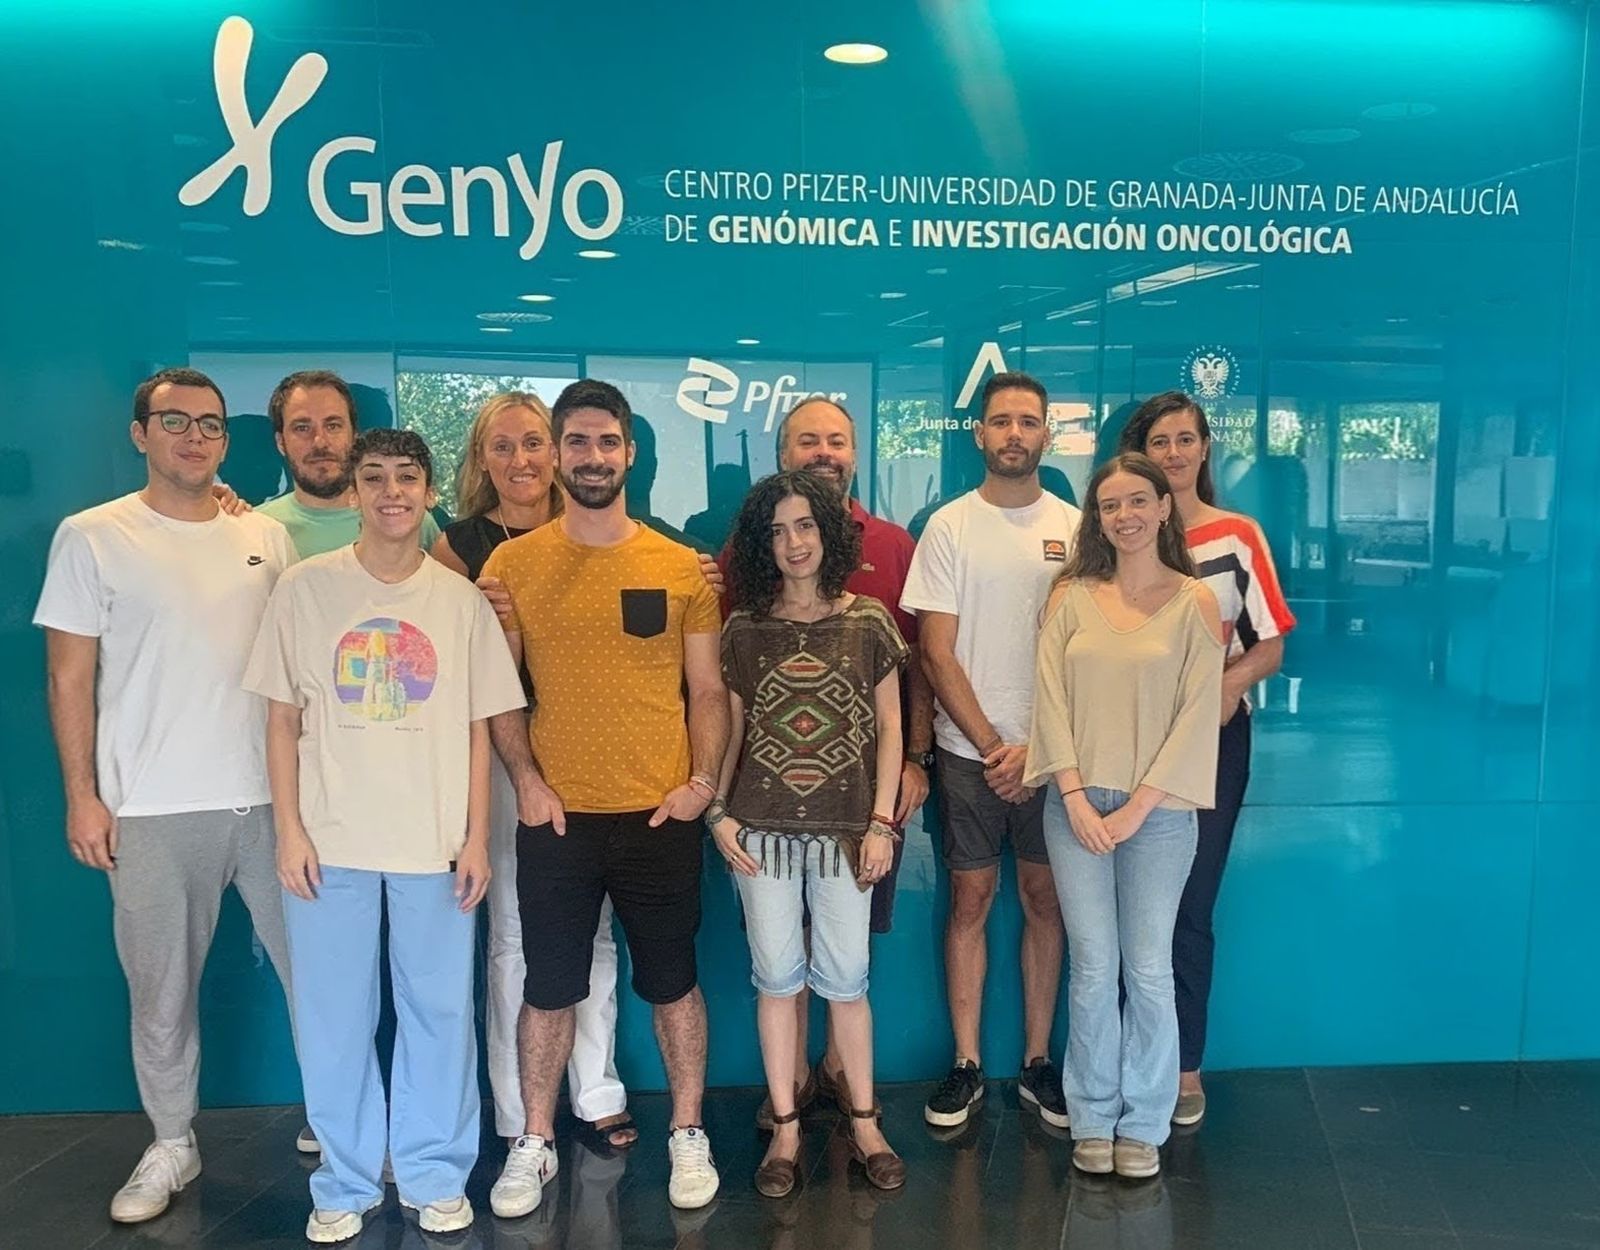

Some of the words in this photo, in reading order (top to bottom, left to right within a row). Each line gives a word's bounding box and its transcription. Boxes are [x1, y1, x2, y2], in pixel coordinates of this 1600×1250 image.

[664, 169, 773, 201] CENTRO
[783, 172, 1057, 208] PFIZER-UNIVERSIDAD
[1066, 179, 1097, 208] DE
[1107, 179, 1326, 212] GRANADA-JUNTA
[1335, 185, 1367, 213] DE
[1373, 182, 1520, 215] ANDALUCÍA
[664, 214, 699, 243] DE
[708, 209, 880, 247] GENÓMICA
[889, 219, 902, 247] E
[912, 217, 1146, 251] INVESTIGACIÓN
[1156, 219, 1353, 254] ONCOLÓGICA
[743, 375, 847, 432] Pfizr
[915, 417, 959, 430] Junta
